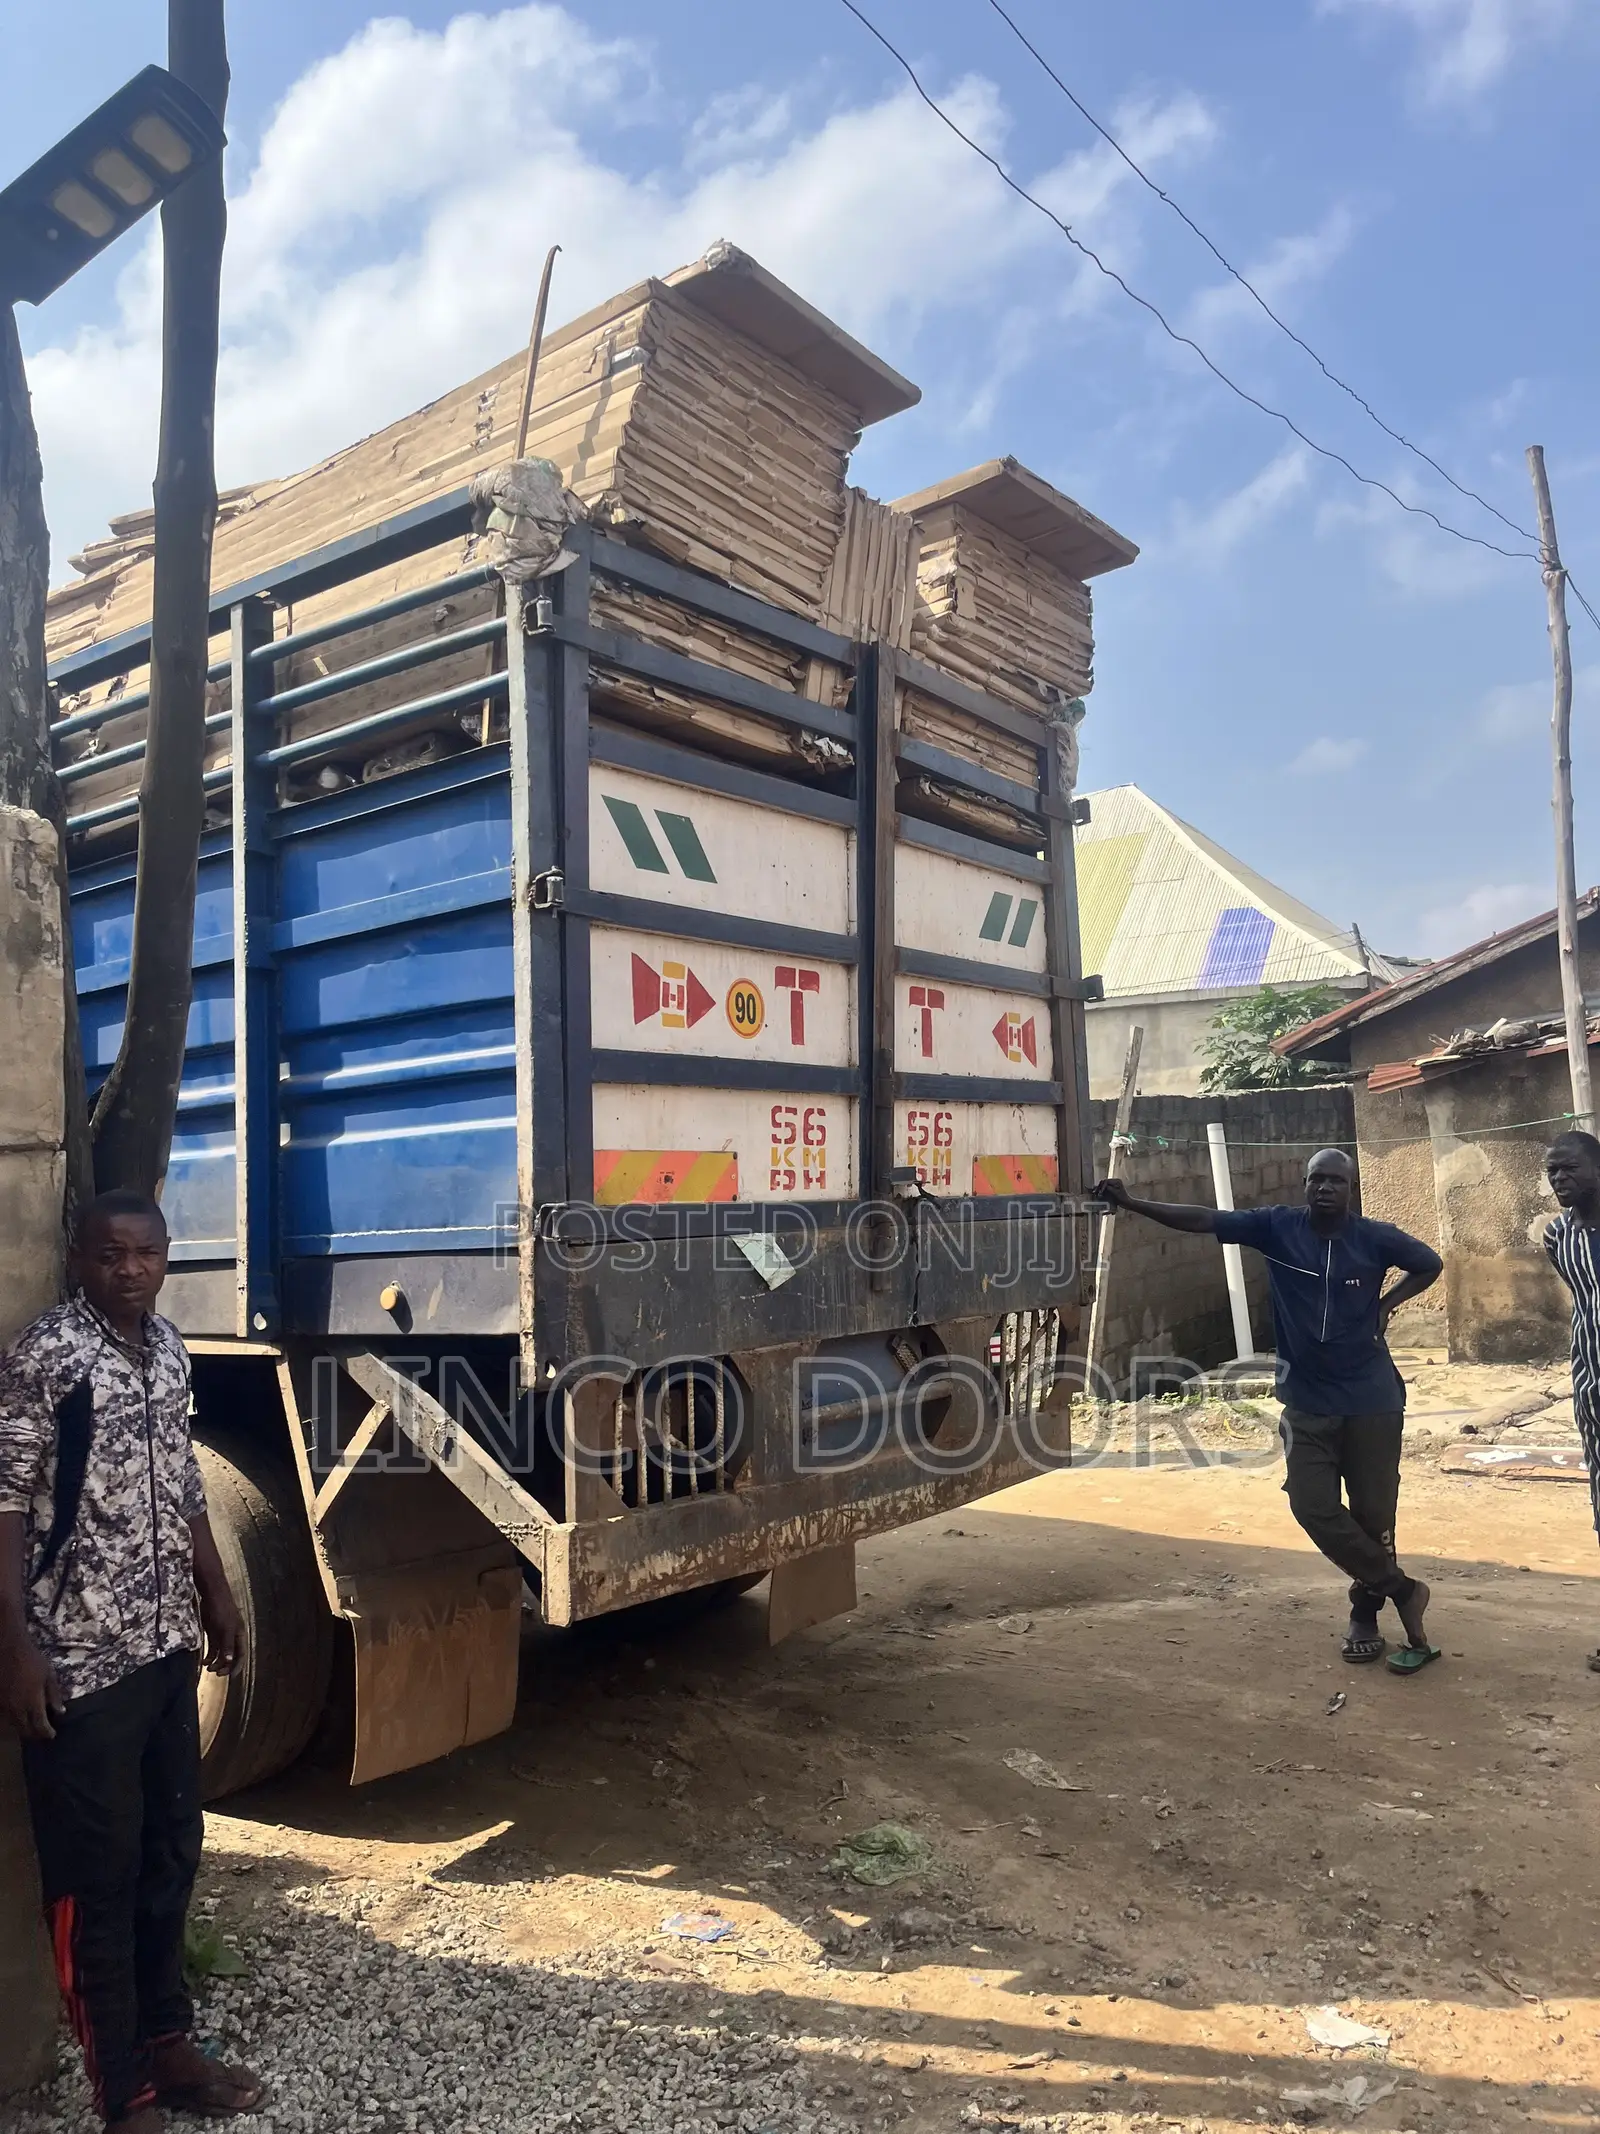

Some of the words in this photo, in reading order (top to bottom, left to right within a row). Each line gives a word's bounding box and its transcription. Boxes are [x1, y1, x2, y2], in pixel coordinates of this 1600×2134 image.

[735, 991, 757, 1025] 90
[774, 966, 820, 1046] T
[909, 986, 945, 1057] T
[771, 1105, 826, 1146] 56
[907, 1111, 953, 1147] 56
[770, 1146, 826, 1168] KM
[907, 1147, 952, 1166] KM
